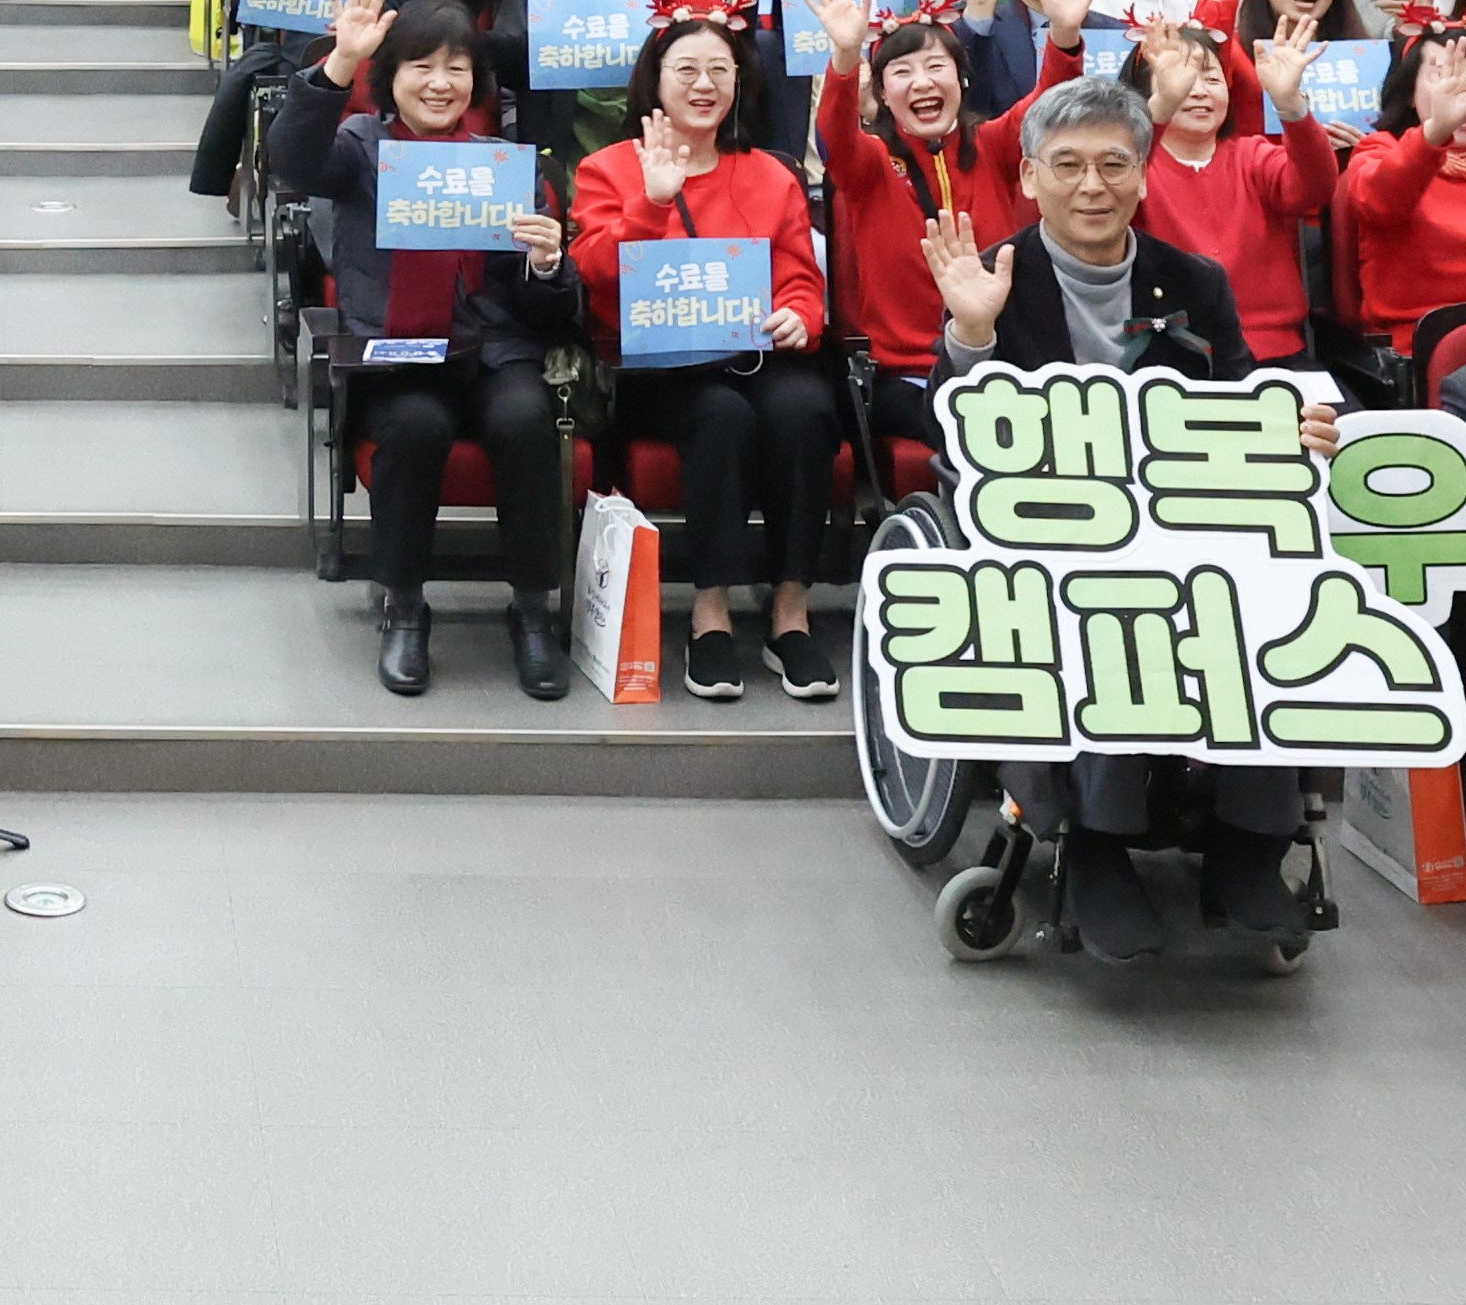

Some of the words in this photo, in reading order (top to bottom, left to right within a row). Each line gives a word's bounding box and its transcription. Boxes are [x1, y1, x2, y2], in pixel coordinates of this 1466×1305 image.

[562, 13, 630, 40] 수료를
[538, 42, 642, 69] 축하합니
[416, 165, 495, 196] 수료를
[386, 199, 523, 229] 축하합니다!
[655, 264, 728, 293] 수료를
[628, 295, 762, 328] 축하합니다!
[949, 372, 1324, 558] 행복
[878, 559, 1453, 751] 캠퍼스
